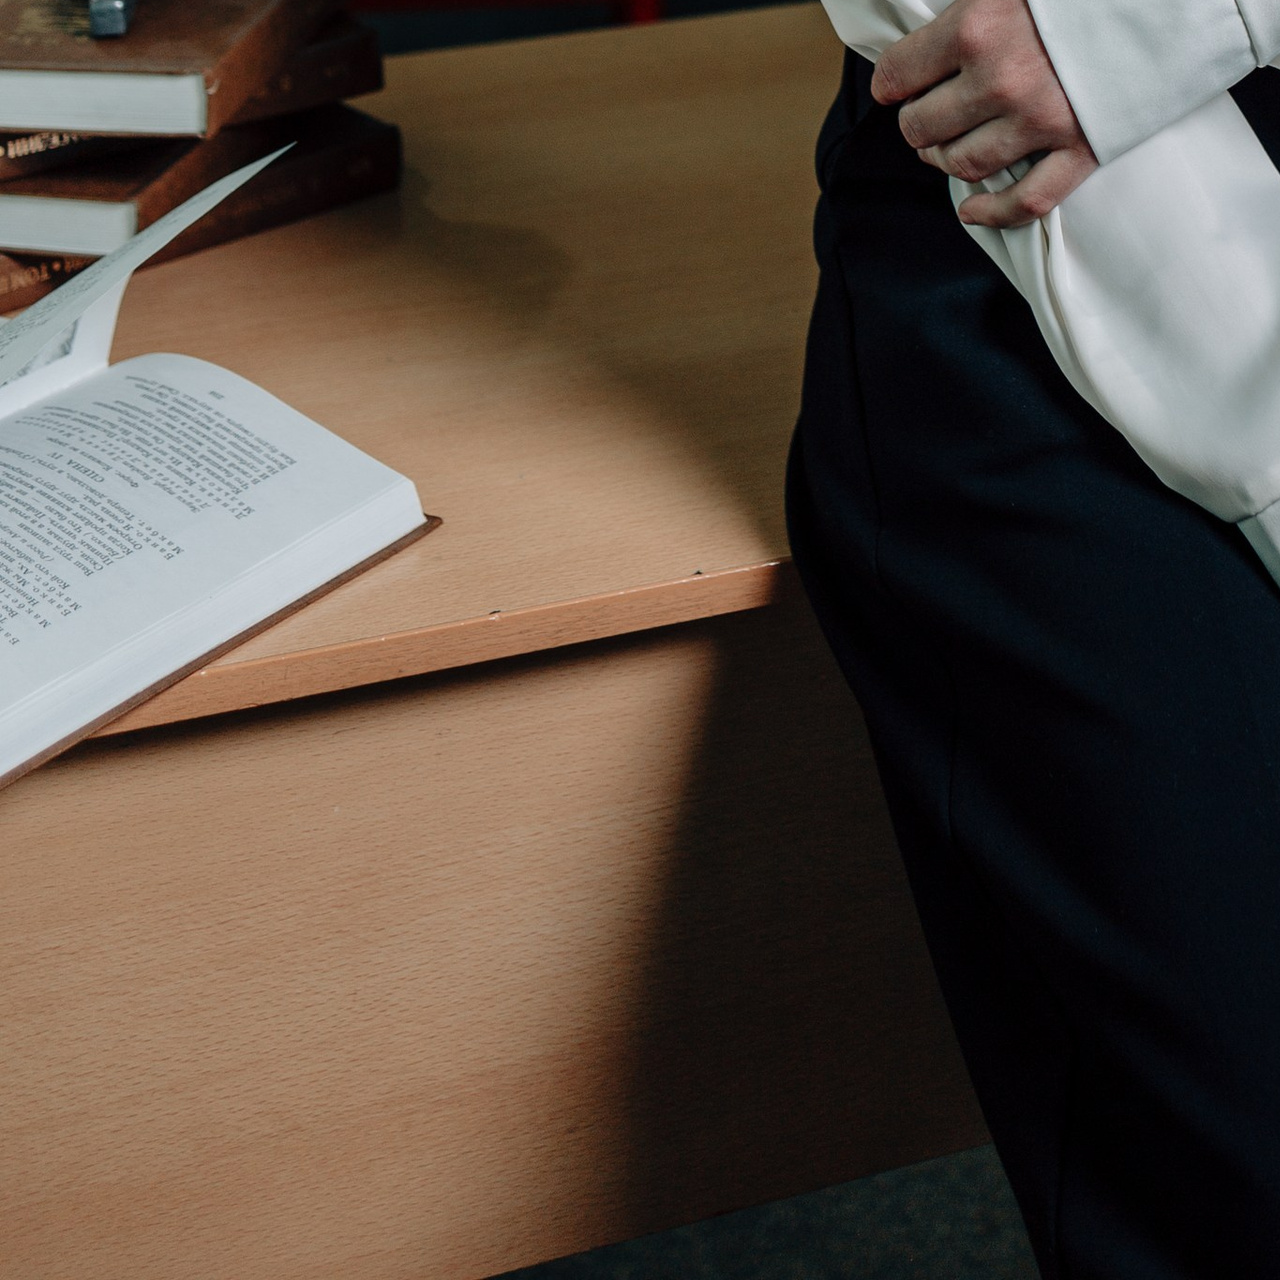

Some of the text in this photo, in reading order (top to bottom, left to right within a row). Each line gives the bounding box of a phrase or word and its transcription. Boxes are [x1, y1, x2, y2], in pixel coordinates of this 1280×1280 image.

[46, 450, 106, 482] СЦЕНА IV
[32, 476, 59, 492] другу
[64, 472, 108, 500] довольно,
[183, 464, 256, 514] Малькольм.
[232, 476, 250, 490] Что
[34, 489, 74, 512] влияние
[56, 490, 80, 504] друг
[196, 484, 248, 520] Дункан.
[8, 506, 31, 520] этой
[42, 504, 68, 522] было
[78, 503, 108, 523] мысль
[105, 498, 136, 521] Теперь
[3, 492, 114, 566] Привык читать. Пойдемте
[66, 519, 84, 532] Что
[70, 511, 108, 536] пройдет
[80, 493, 174, 560] Банко. Я очень рад.
[44, 528, 79, 552] друзья,
[82, 531, 126, 560] (Банко.)
[105, 522, 144, 550] Откроем
[106, 535, 134, 555] Когда
[136, 519, 184, 554] Макбет.
[16, 522, 94, 576] Ваш труд записан
[78, 550, 104, 571] Сюда,
[10, 573, 30, 587] Мы
[16, 562, 33, 575] Ах,
[33, 563, 70, 590] Кой-что
[30, 586, 72, 616] Банко.
[32, 574, 82, 611] Макбет.
[1, 604, 19, 618] Все
